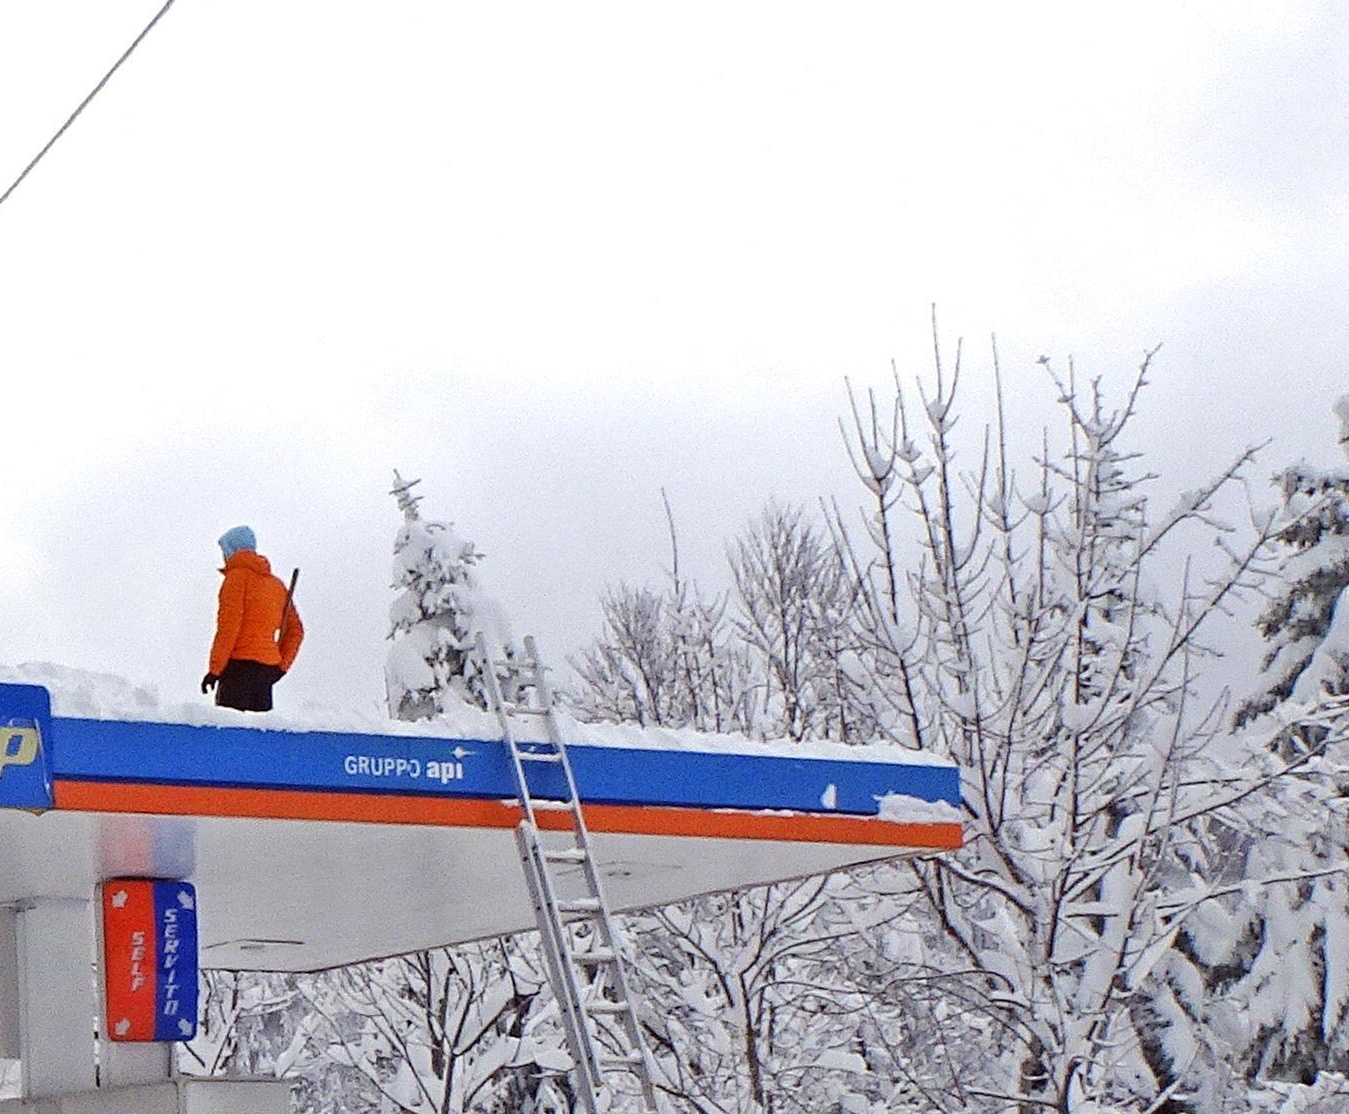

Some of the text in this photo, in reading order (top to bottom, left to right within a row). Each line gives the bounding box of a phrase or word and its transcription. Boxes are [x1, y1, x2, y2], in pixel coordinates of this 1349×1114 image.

[344, 755, 464, 785] GRUPPO api
[130, 931, 146, 993] SELF
[163, 907, 180, 1016] SERVITO
